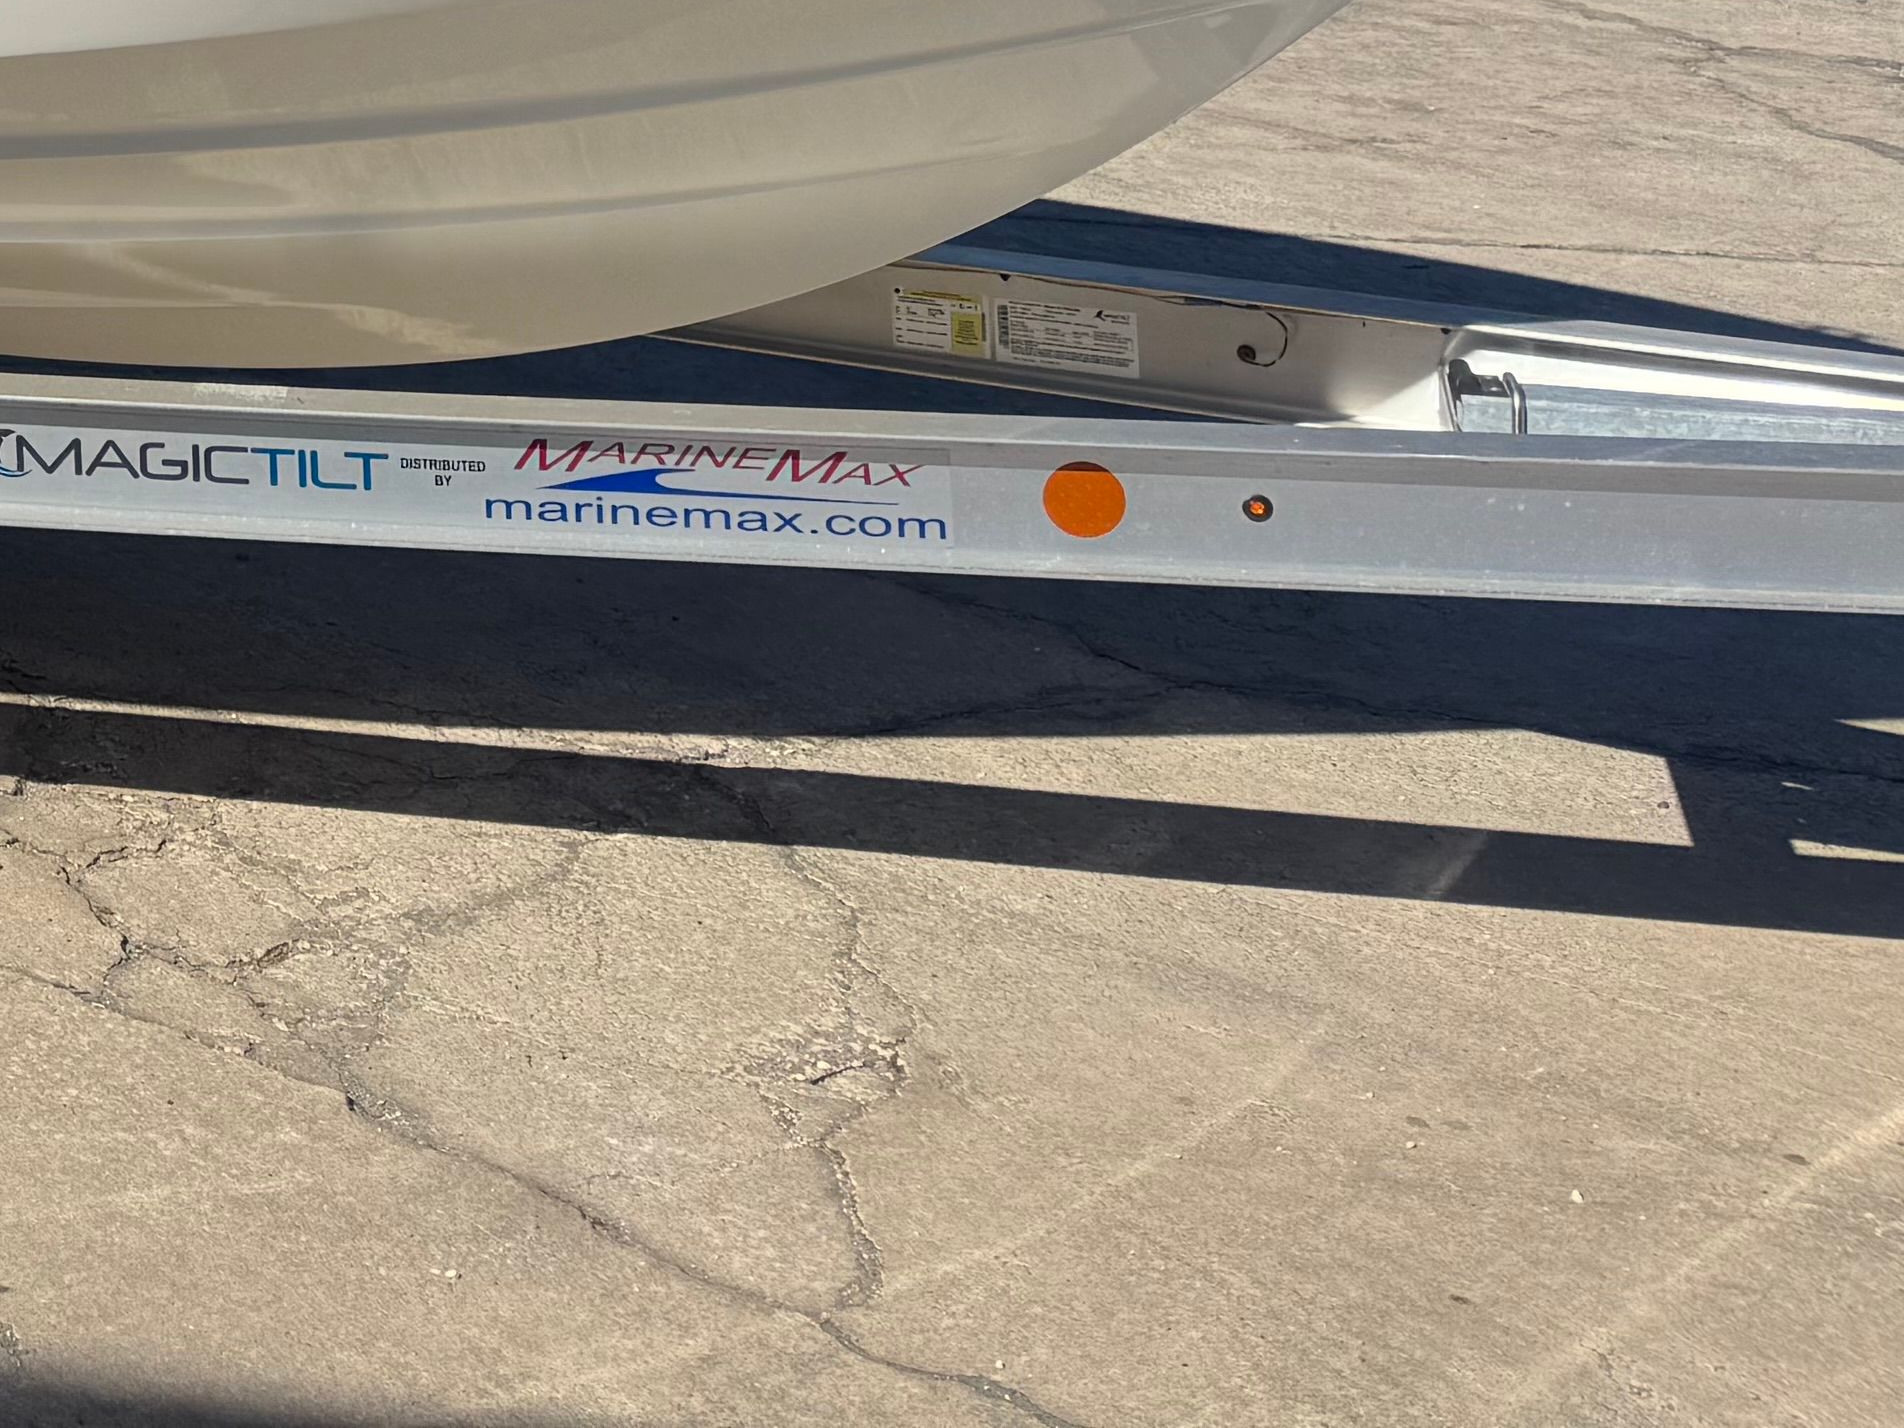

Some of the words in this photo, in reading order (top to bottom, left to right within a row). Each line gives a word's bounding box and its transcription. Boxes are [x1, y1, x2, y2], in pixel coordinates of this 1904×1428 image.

[15, 434, 389, 491] MAGICTILT
[399, 457, 486, 473] DISTRIBUTED
[434, 475, 452, 487] BY
[485, 496, 947, 540] marinemax.com
